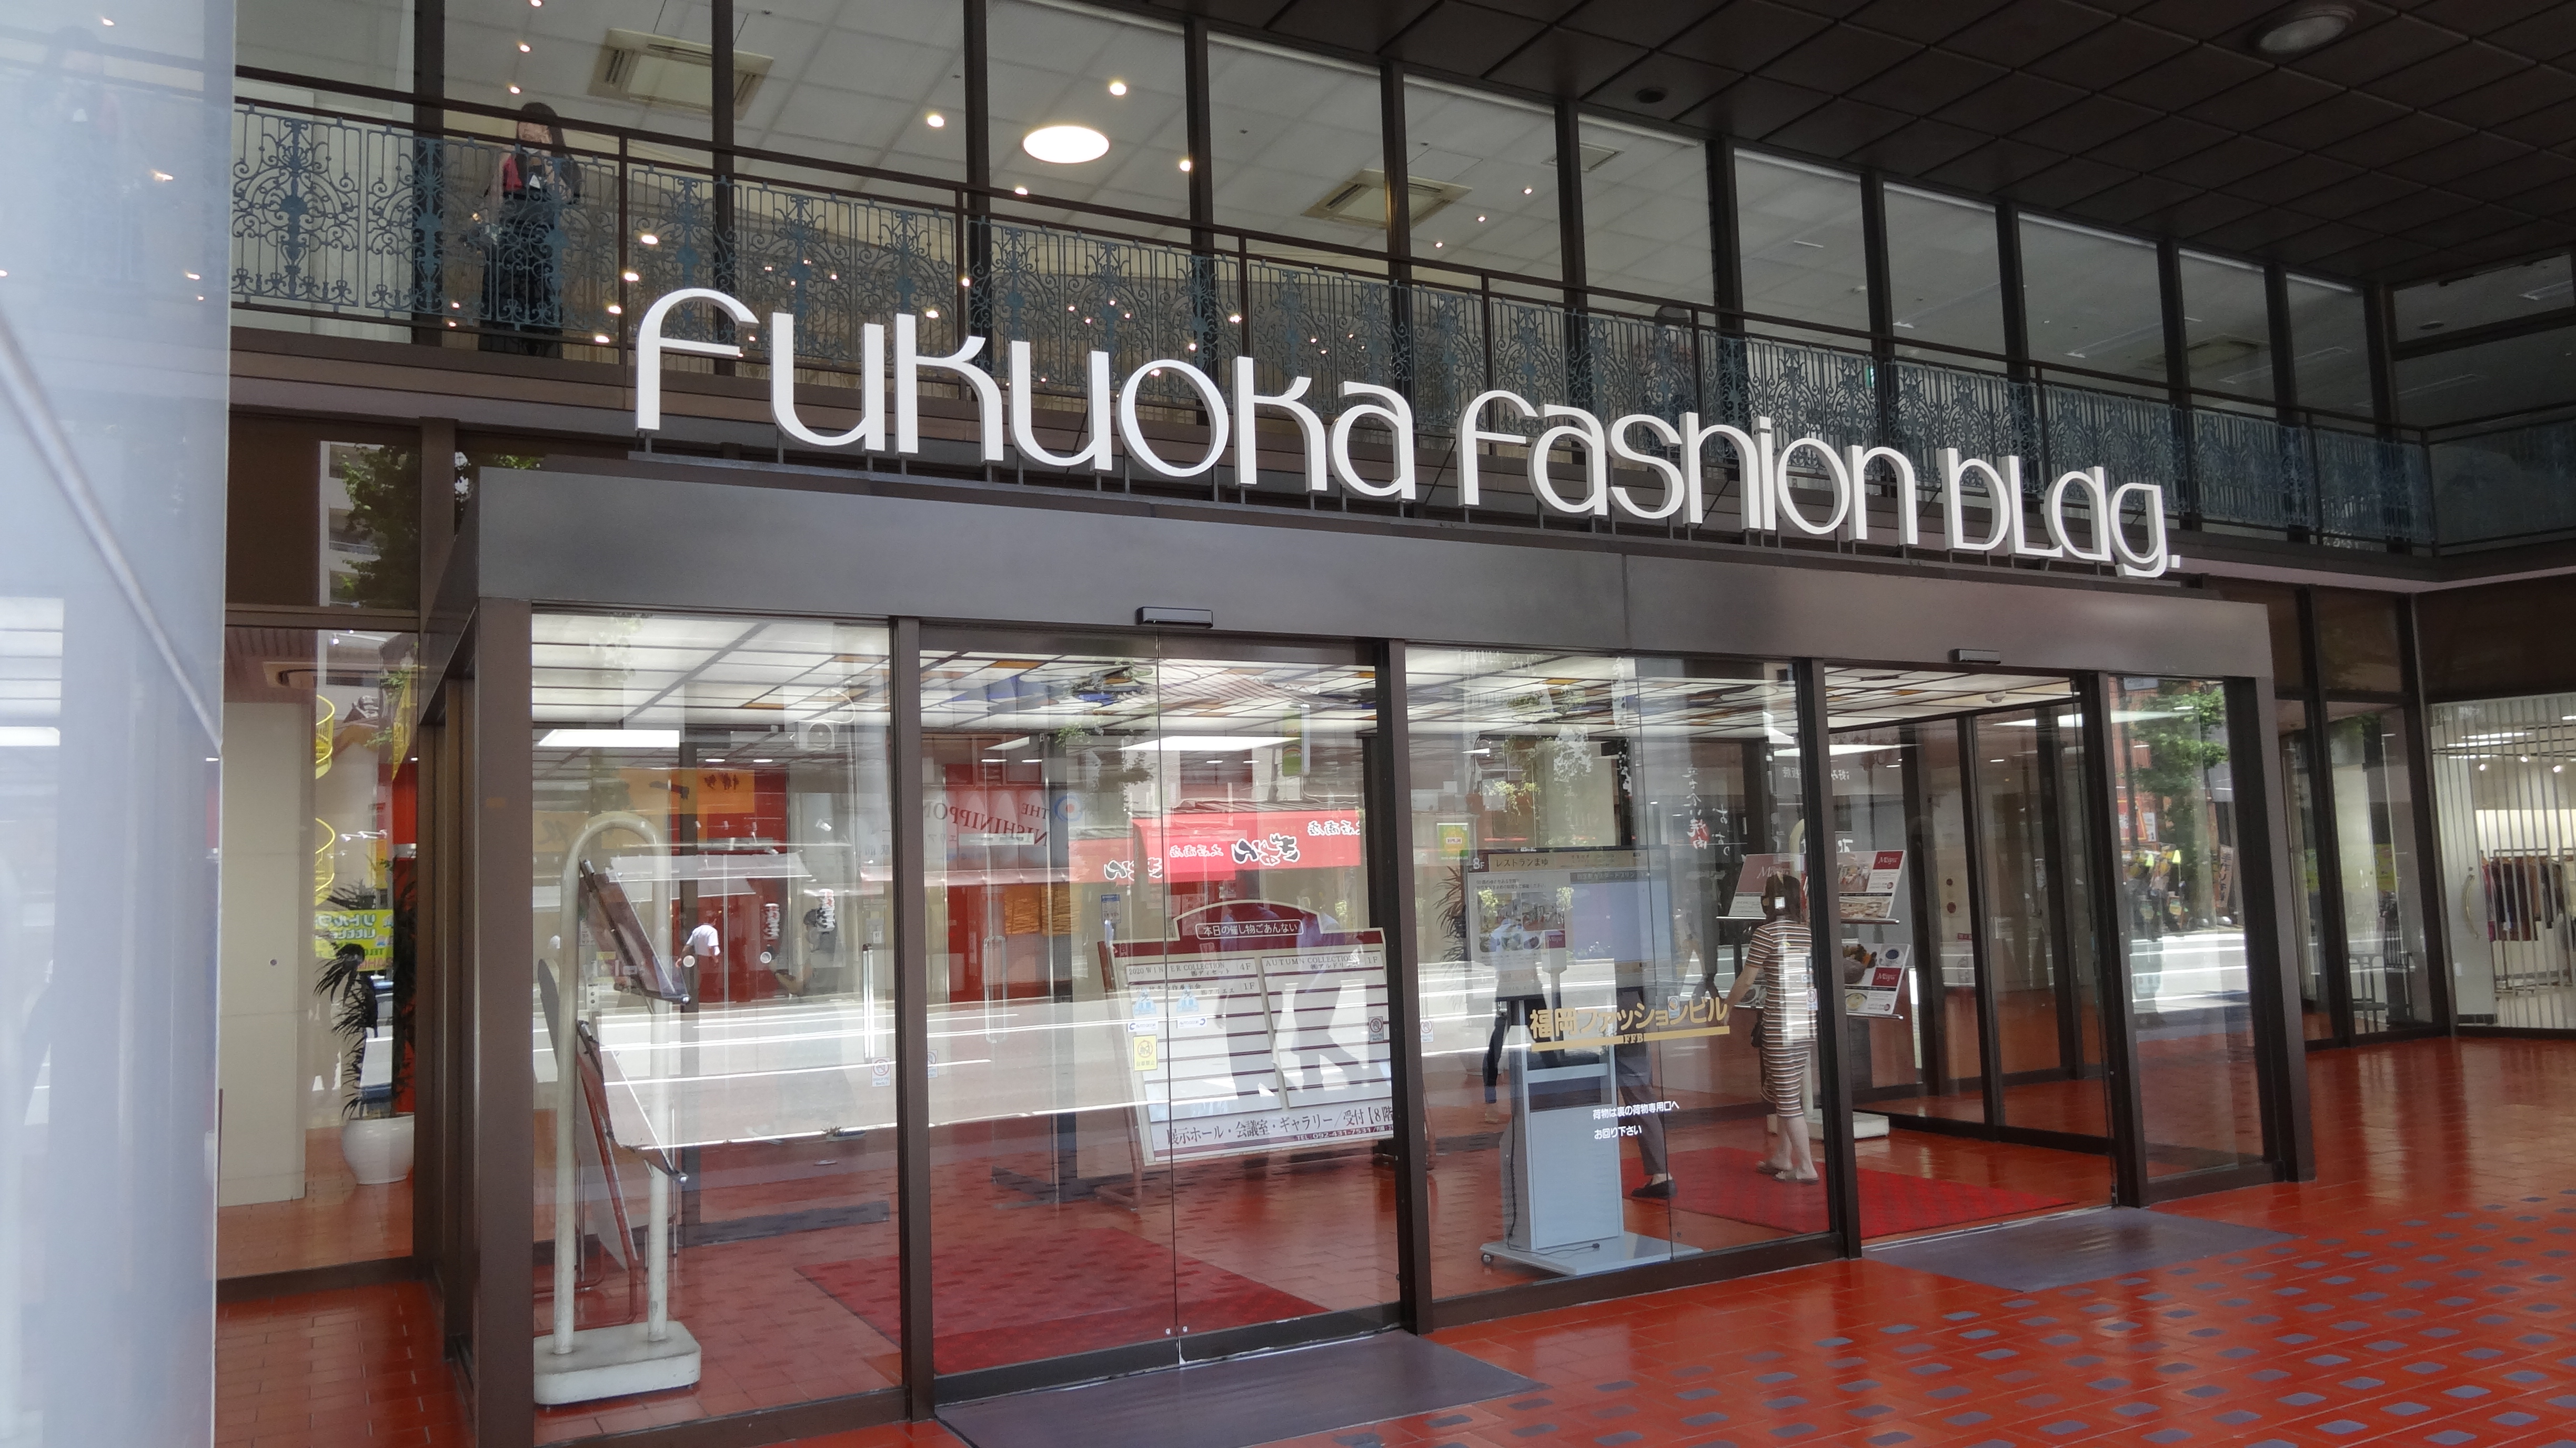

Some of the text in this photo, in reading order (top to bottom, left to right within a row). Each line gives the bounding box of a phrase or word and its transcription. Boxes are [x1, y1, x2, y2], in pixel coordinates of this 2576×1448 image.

[1473, 857, 1485, 870] 8F
[1496, 858, 1548, 868] レストランまゆ
[1203, 923, 1298, 937] 本日の催し物ごあんない
[1265, 958, 1305, 967] AUTUMN
[1367, 956, 1378, 964] 1F
[1145, 965, 1182, 973] WINER
[1183, 962, 1225, 971] COLLECTION
[1240, 962, 1251, 971] 4F
[1243, 982, 1255, 990] 1F
[1530, 996, 1728, 1039] 福岡ファッションビル
[1623, 1033, 1644, 1044] FFB
[1593, 1100, 1680, 1120] 荷物は裏の荷物専用口へ
[1594, 1124, 1643, 1140] お回り下さい
